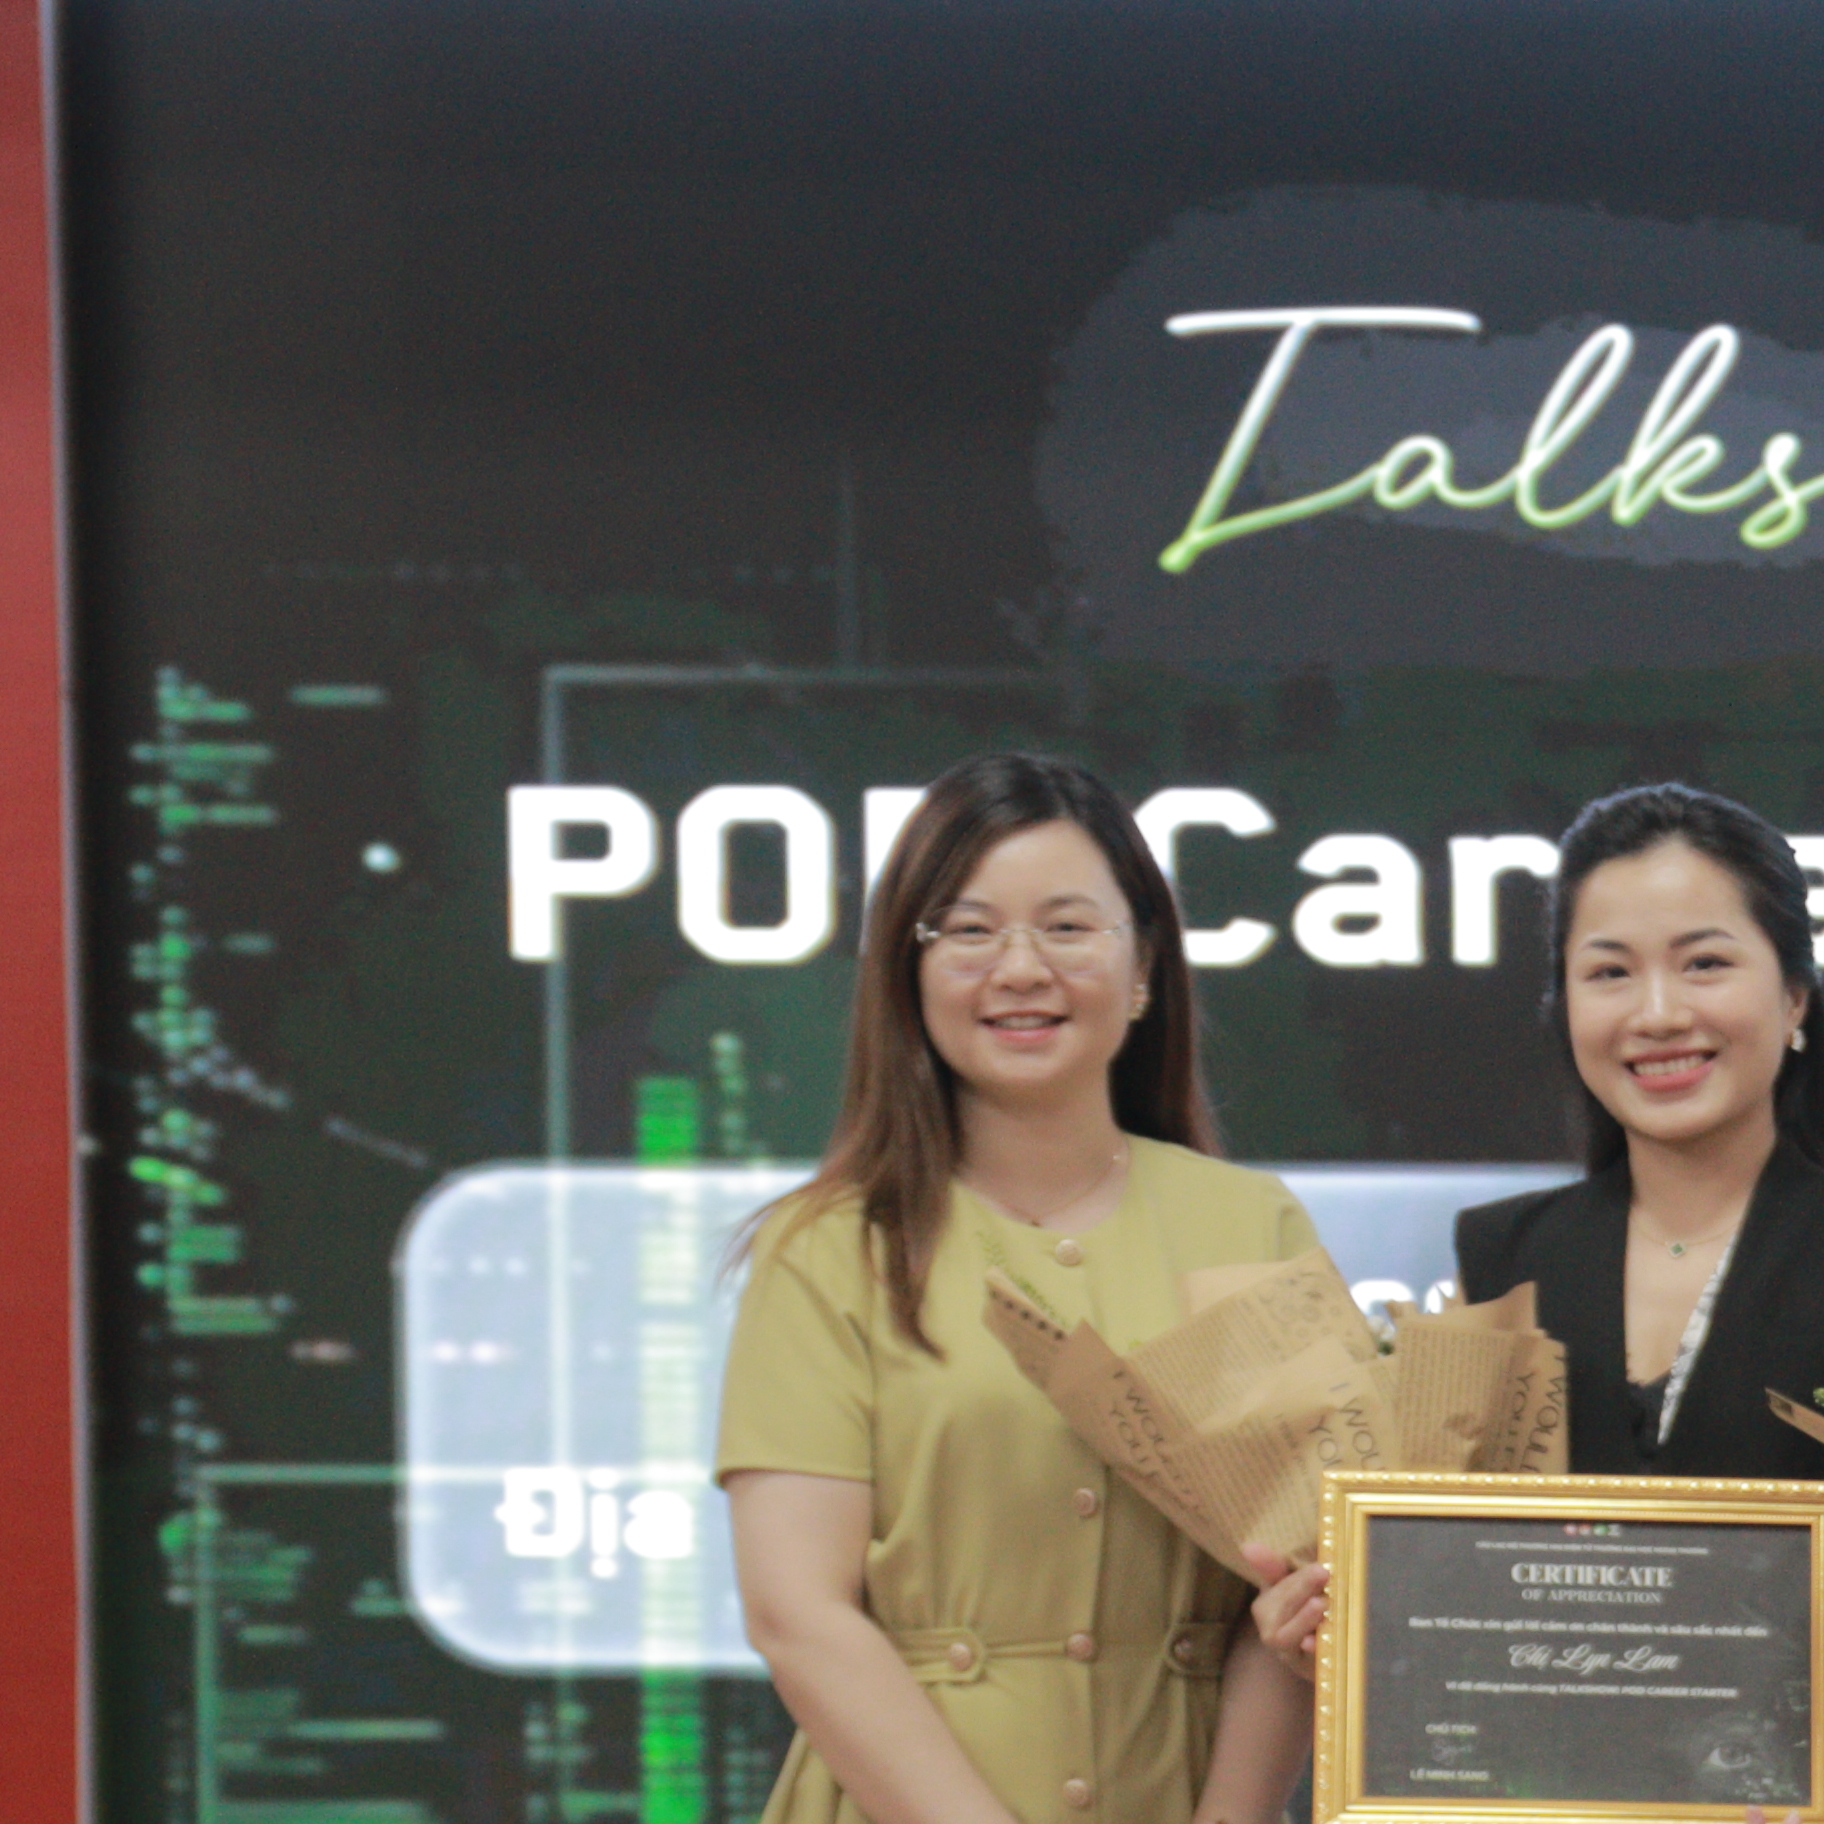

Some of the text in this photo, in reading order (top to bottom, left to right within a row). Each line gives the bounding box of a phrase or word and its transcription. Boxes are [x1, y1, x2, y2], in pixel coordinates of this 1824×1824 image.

[1510, 1562, 1673, 1587] CERTIFICATE
[1521, 1588, 1661, 1604] OF APPRECIATION
